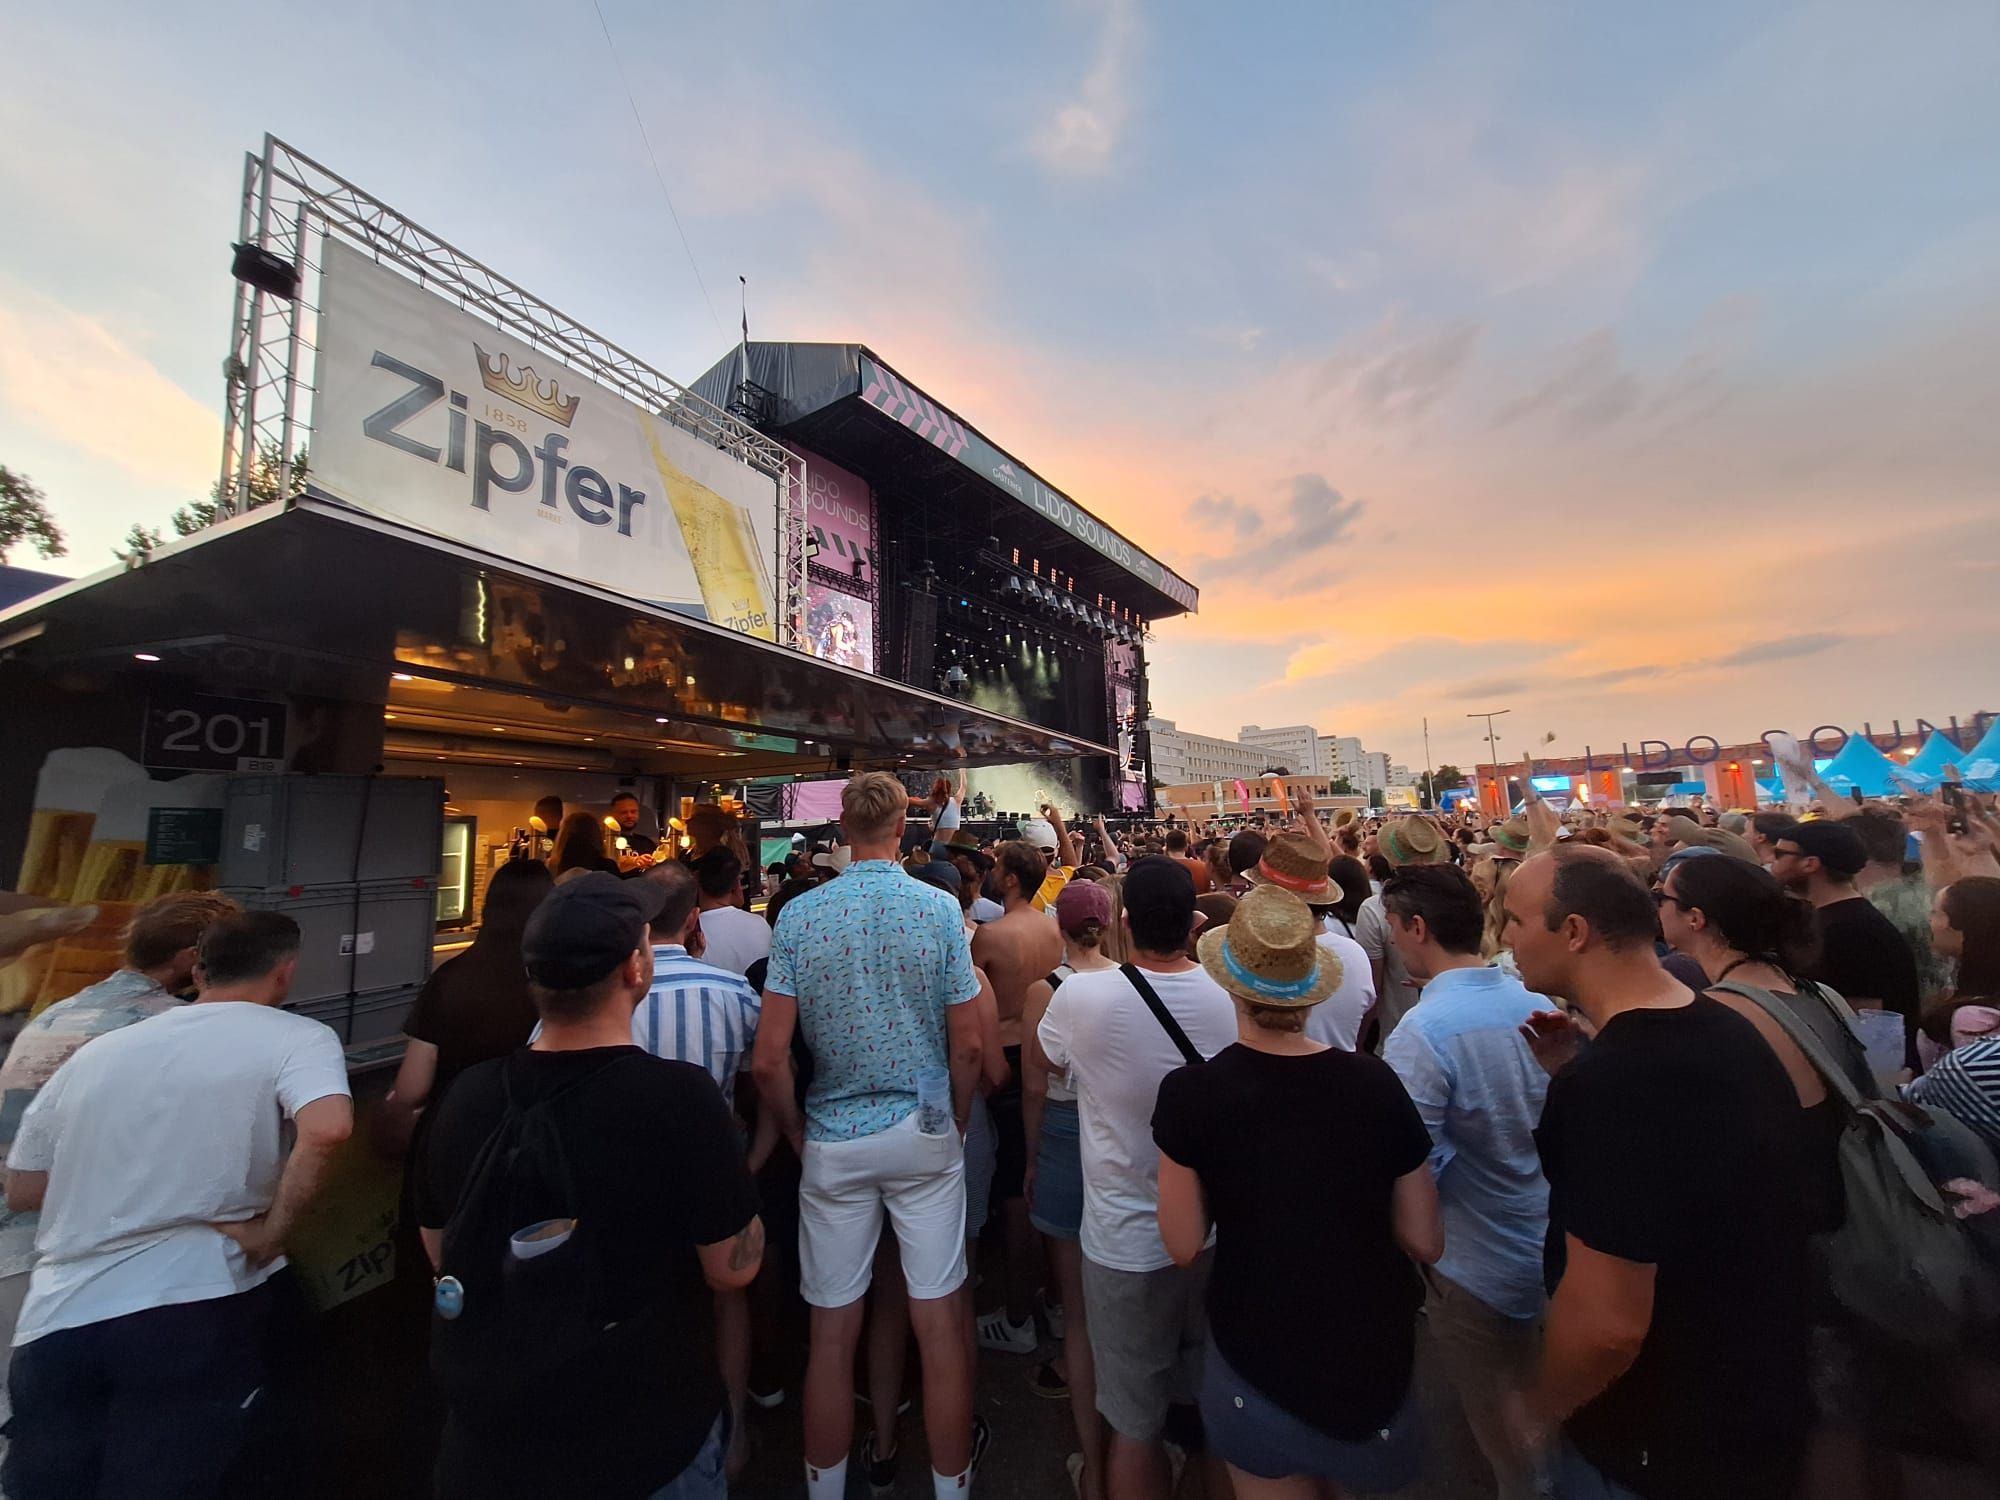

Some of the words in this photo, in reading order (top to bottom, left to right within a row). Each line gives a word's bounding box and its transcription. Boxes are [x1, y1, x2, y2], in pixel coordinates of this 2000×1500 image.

[484, 403, 528, 433] 1858
[363, 350, 646, 537] Zipfer
[806, 471, 840, 499] IDO
[1033, 482, 1072, 528] LIDO
[1076, 513, 1130, 566] SOUNDS
[162, 710, 269, 756] 201
[1585, 735, 1720, 772] LIDO
